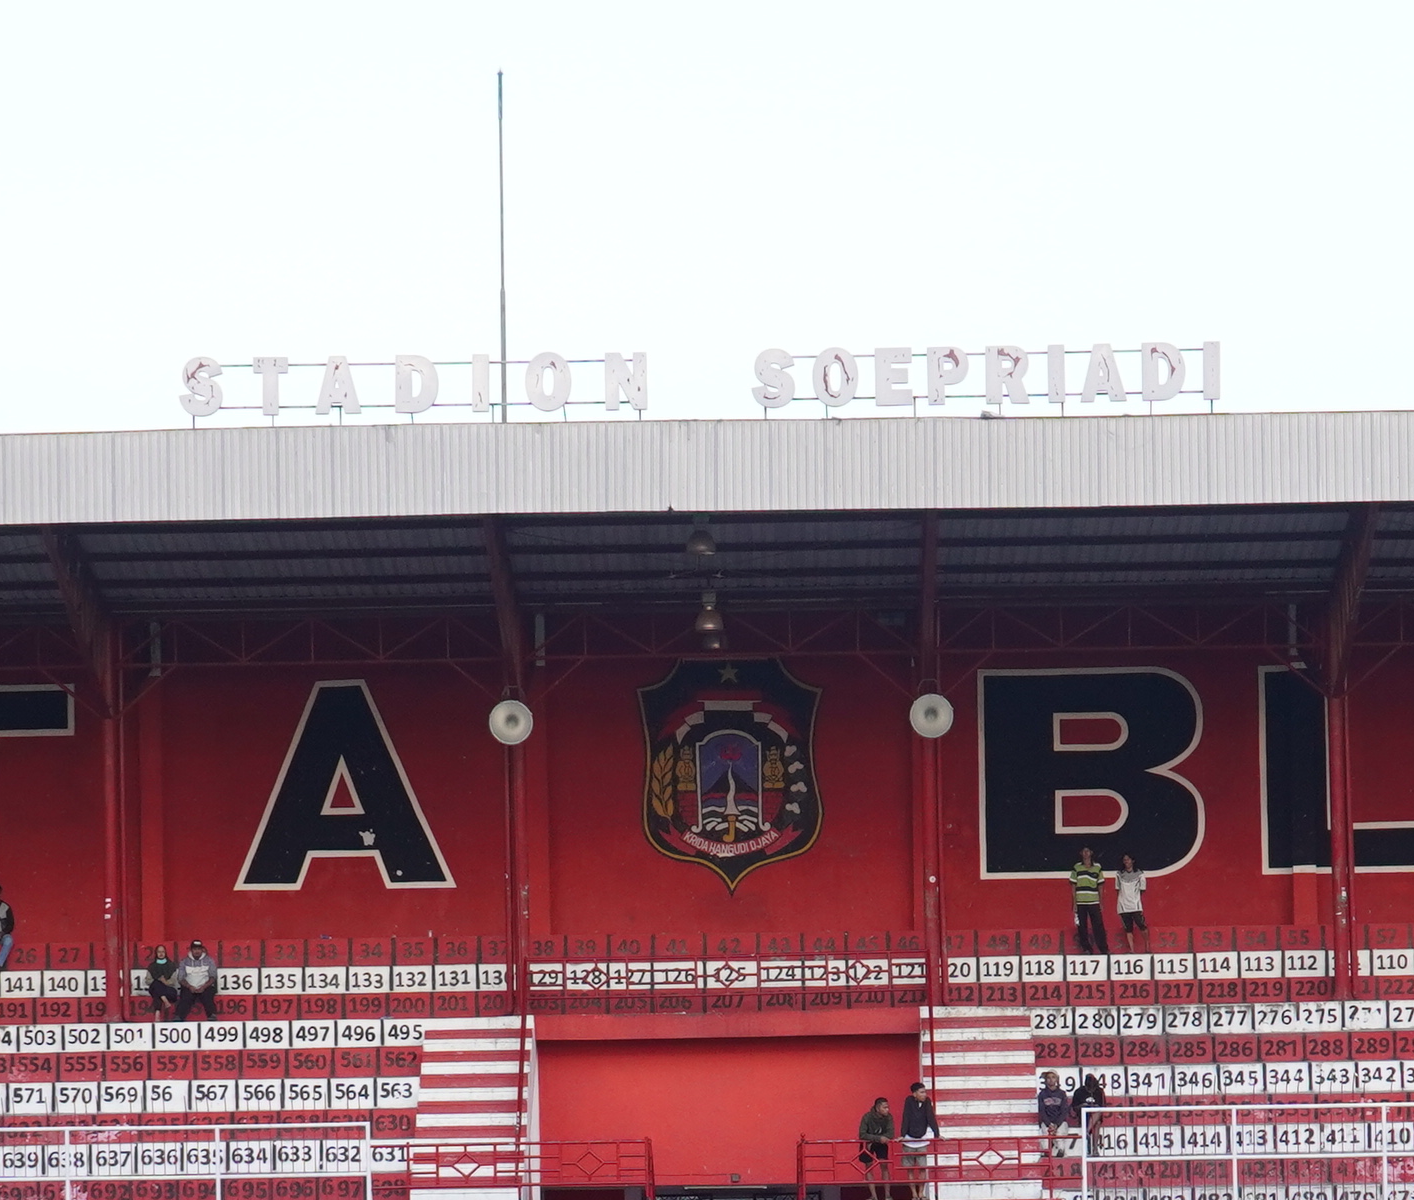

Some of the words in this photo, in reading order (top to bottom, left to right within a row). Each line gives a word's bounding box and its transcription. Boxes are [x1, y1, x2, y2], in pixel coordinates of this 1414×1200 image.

[178, 349, 648, 419] STADION
[751, 340, 1222, 408] SOEPRIADI
[751, 830, 778, 850] DJAYA
[983, 960, 1014, 977] 119
[1069, 959, 1100, 976] 117
[1157, 958, 1188, 975] 115
[1244, 956, 1275, 972] 113
[48, 976, 79, 993] 140
[220, 974, 253, 991] 136
[307, 973, 340, 989] 134
[395, 971, 427, 988] 132
[1034, 1013, 1070, 1030] 281
[1167, 1011, 1203, 1028] 278
[1257, 1008, 1292, 1026] 276
[23, 1029, 56, 1046] 503
[204, 1026, 239, 1043] 499
[295, 1025, 330, 1042] 497
[387, 1024, 423, 1041] 495
[1130, 1072, 1165, 1090] 347
[1222, 1069, 1258, 1088] 345
[1361, 1066, 1396, 1084] 342
[243, 1084, 276, 1102] 566
[335, 1083, 370, 1101] 564
